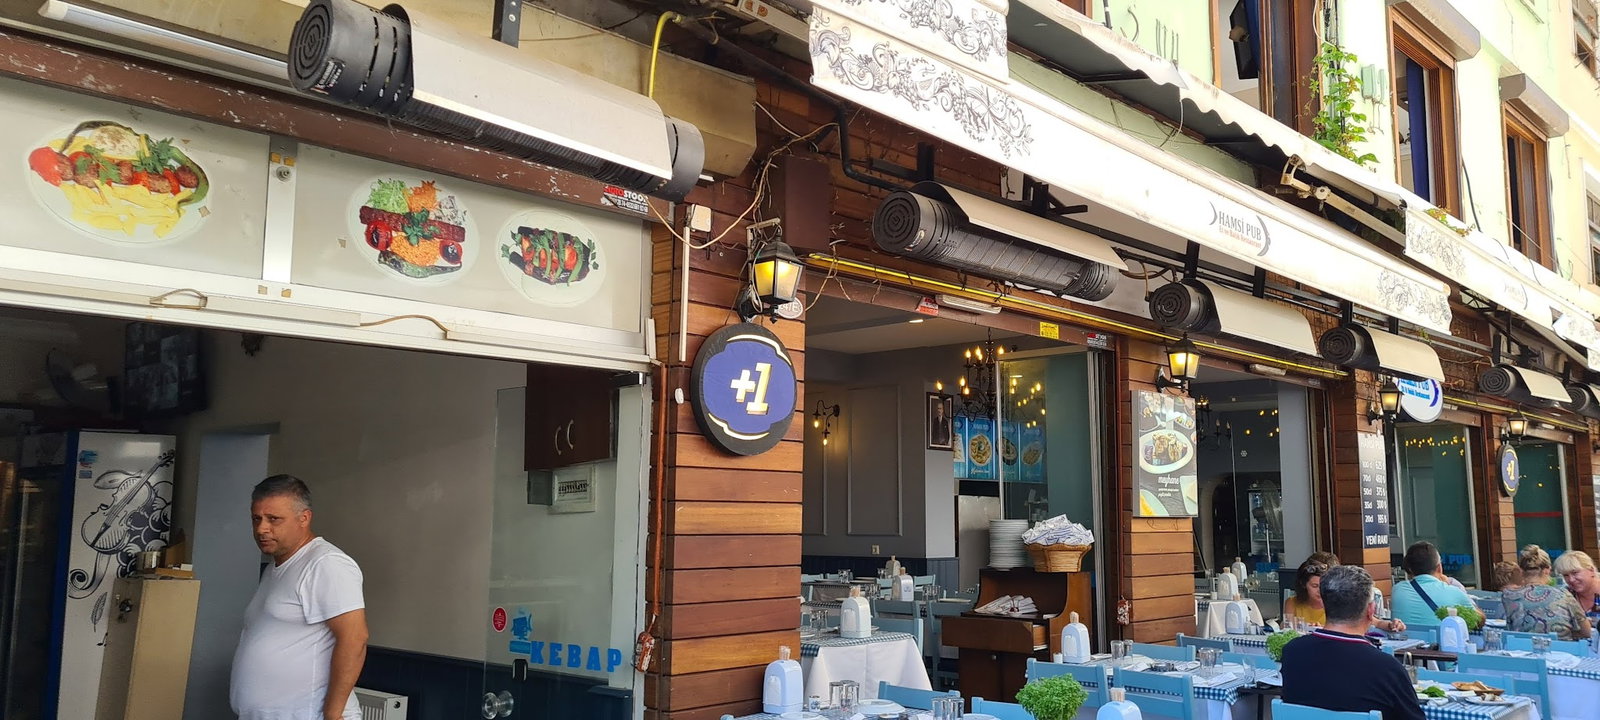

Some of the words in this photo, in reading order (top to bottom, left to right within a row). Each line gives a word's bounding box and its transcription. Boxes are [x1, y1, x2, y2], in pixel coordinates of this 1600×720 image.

[1246, 224, 1262, 240] PUB
[730, 362, 773, 416] +1
[1506, 460, 1515, 480] +1
[530, 640, 622, 673] KEBAP
